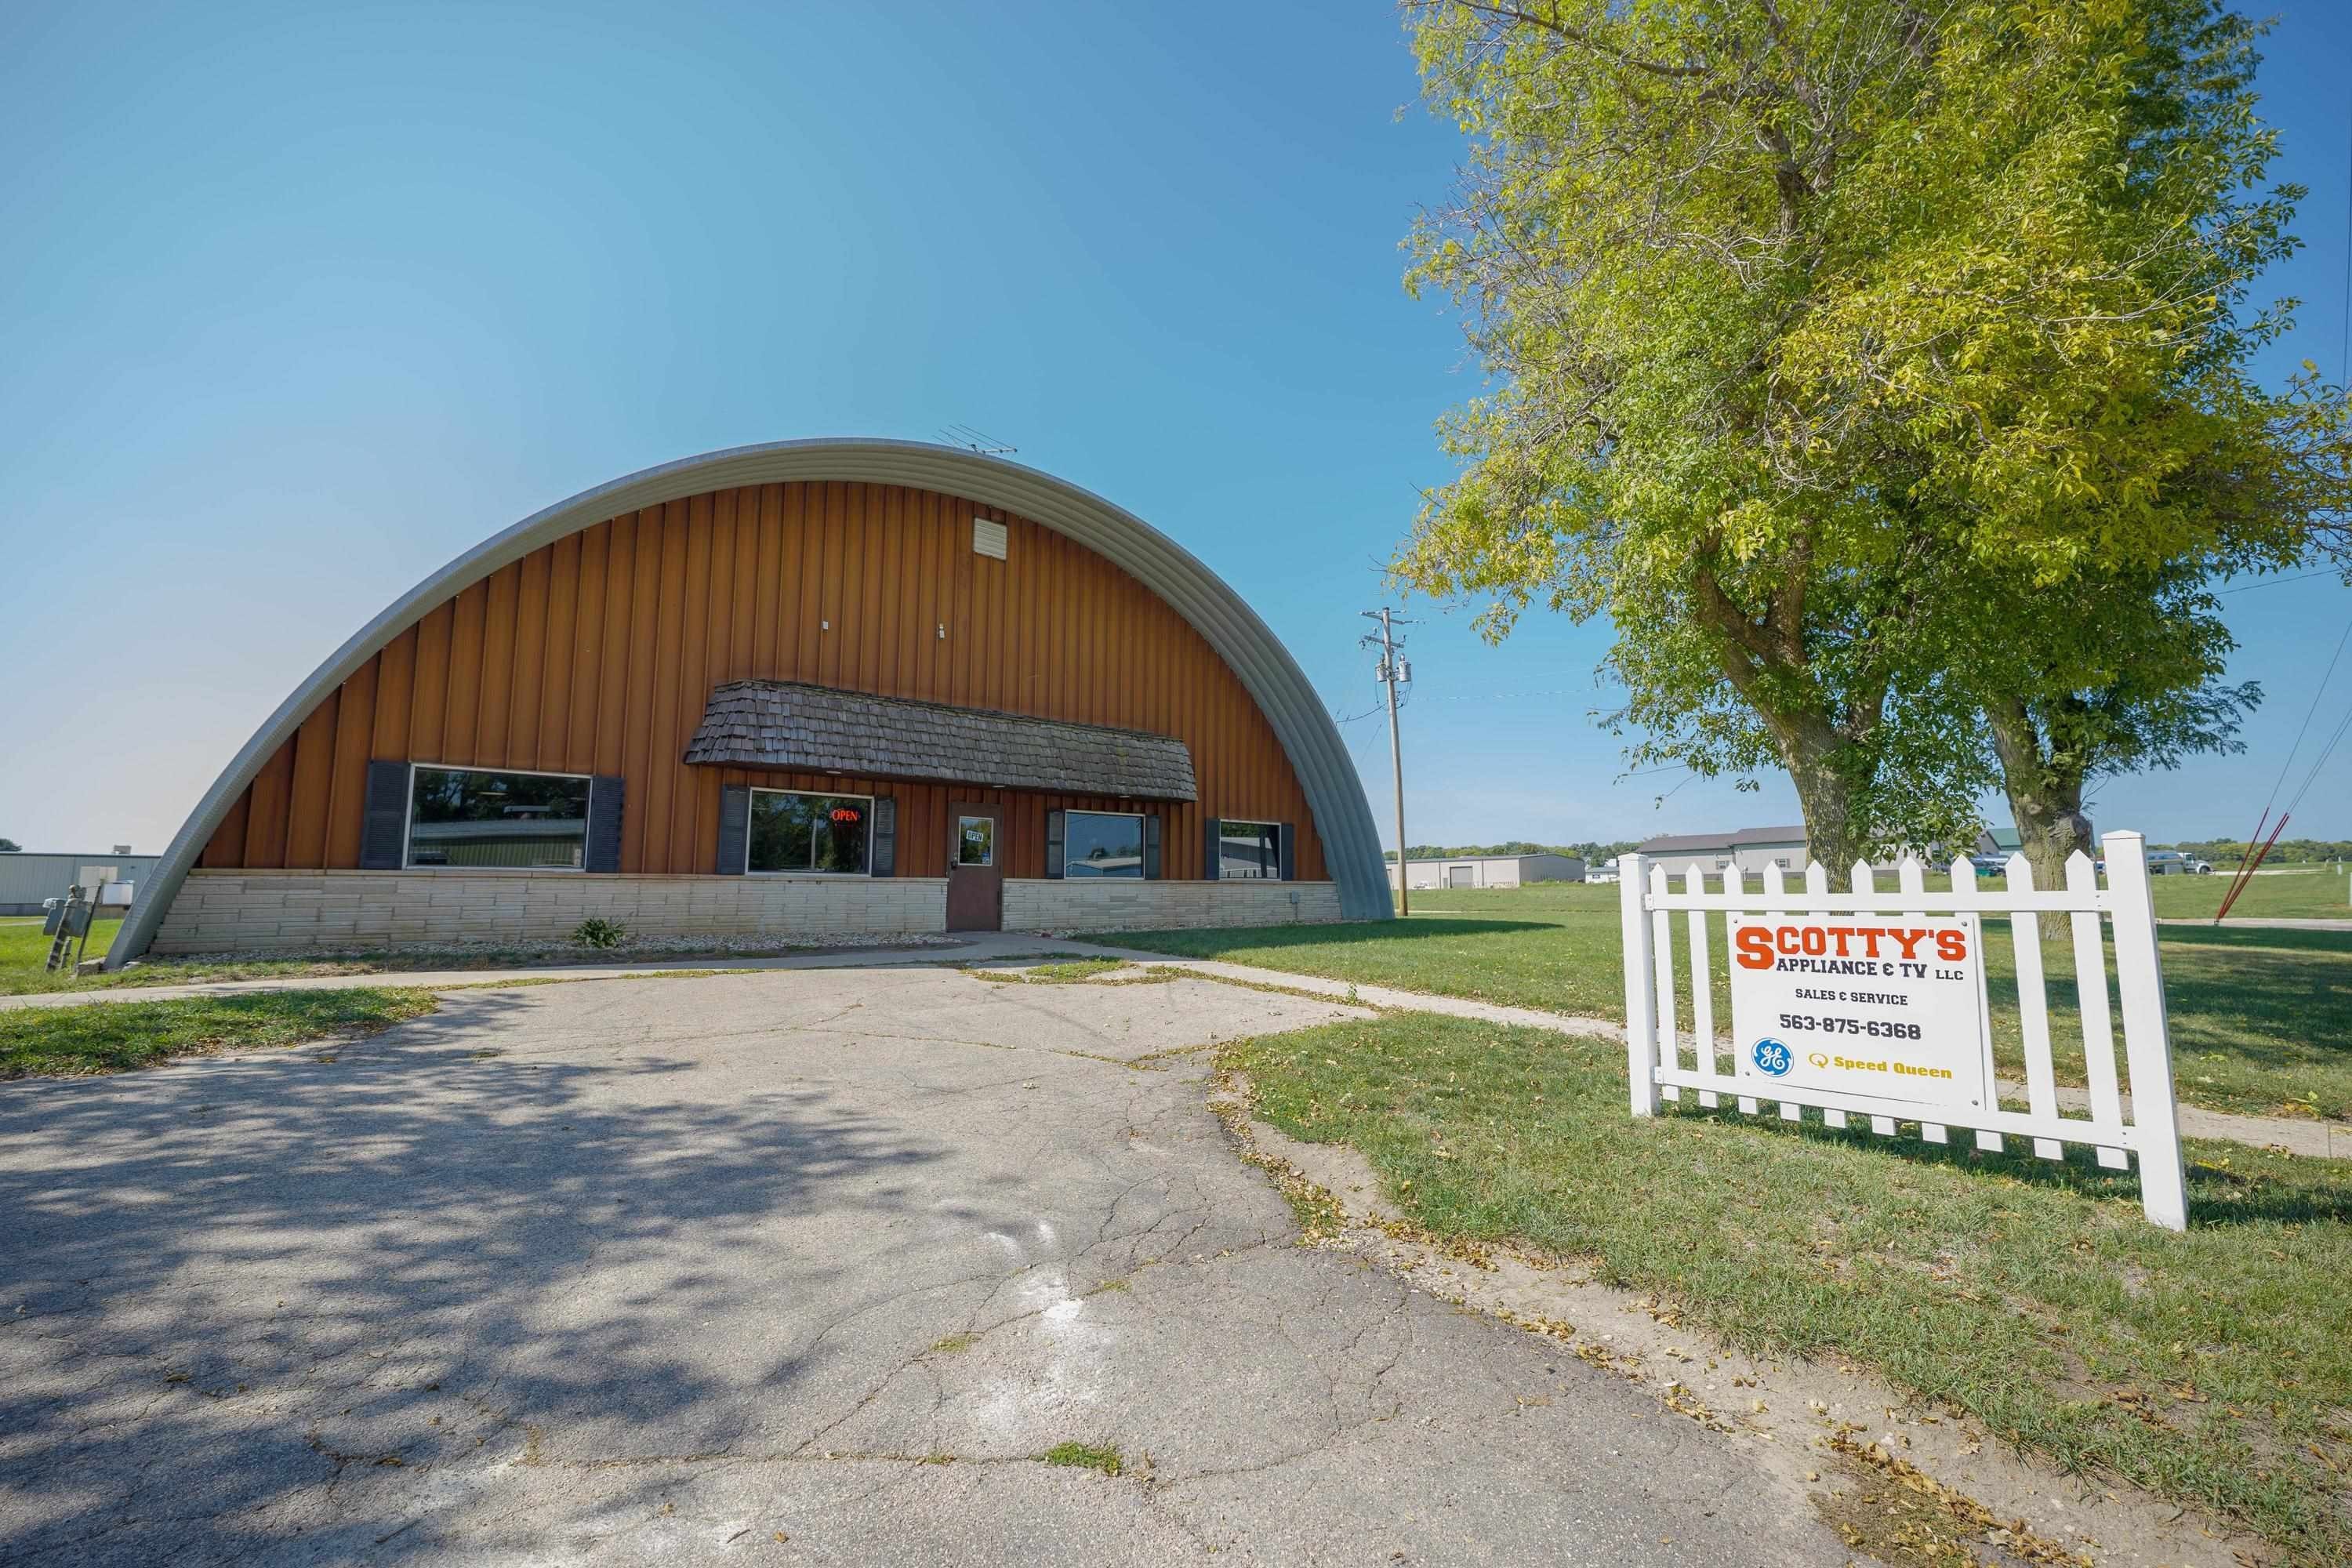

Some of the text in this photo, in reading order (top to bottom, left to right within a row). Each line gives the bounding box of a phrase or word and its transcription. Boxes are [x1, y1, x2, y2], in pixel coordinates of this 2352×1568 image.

[832, 809, 858, 821] OPEN
[967, 830, 983, 841] OPEN
[1736, 927, 1967, 971] SCOTTY'S
[1776, 958, 1964, 981] APPLIANCE & TV LLC
[1795, 988, 1908, 1006] SALES & SERVICE
[1780, 1013, 1922, 1040] 563-875-6368
[1834, 1056, 1888, 1073] Speed
[1893, 1062, 1952, 1080] Queen
